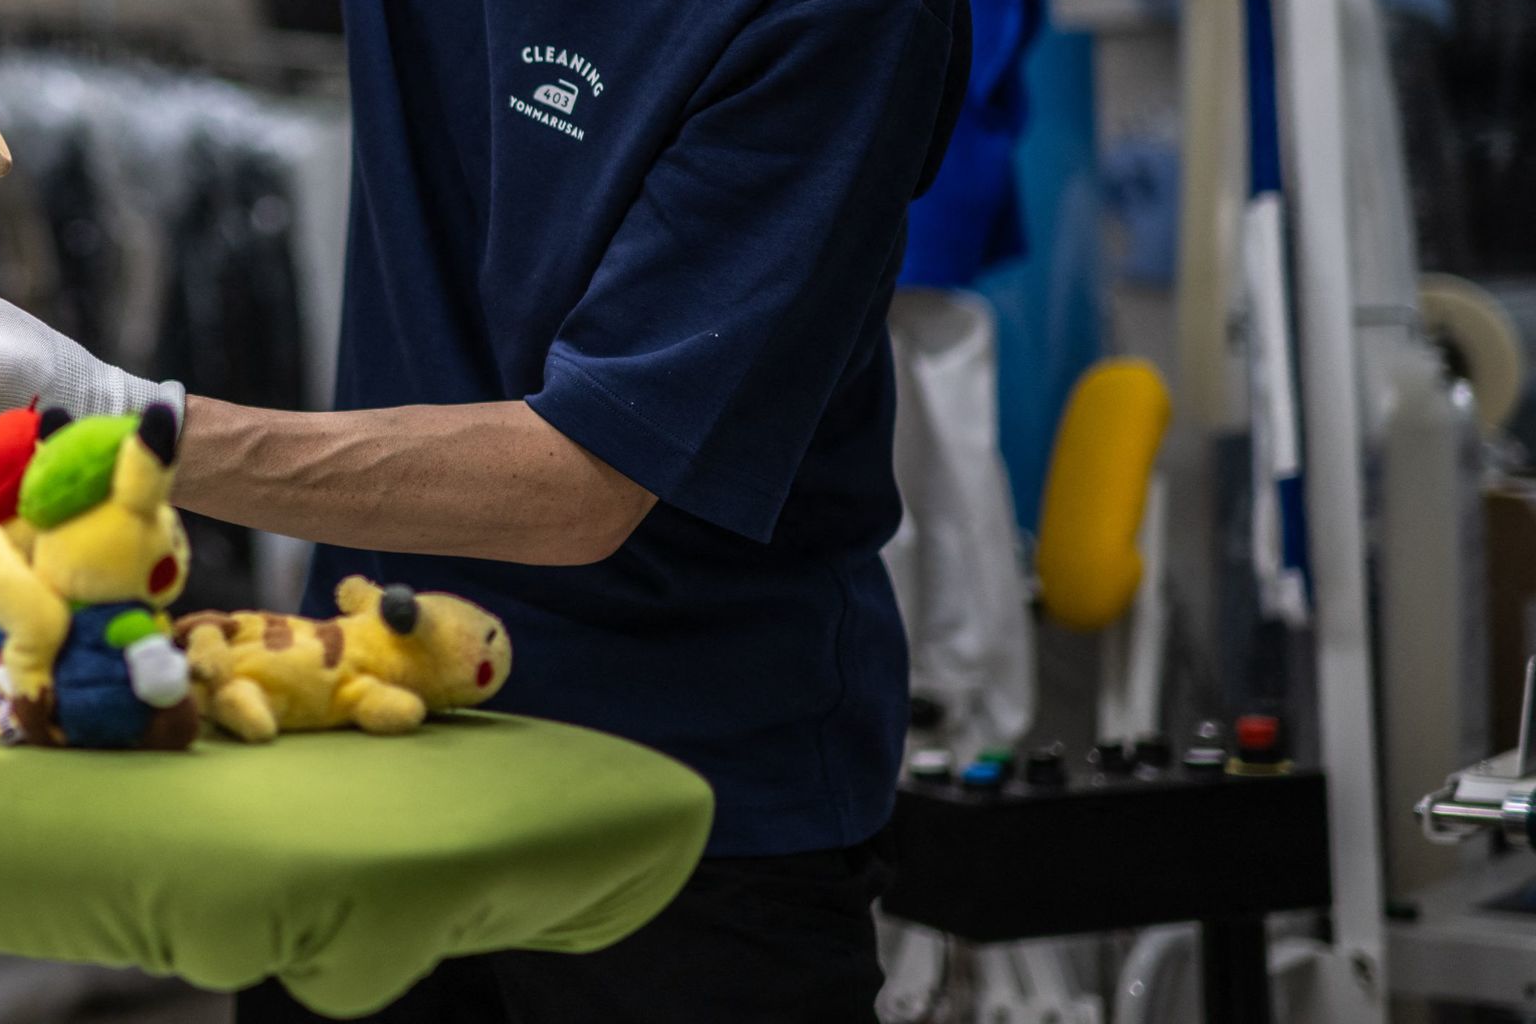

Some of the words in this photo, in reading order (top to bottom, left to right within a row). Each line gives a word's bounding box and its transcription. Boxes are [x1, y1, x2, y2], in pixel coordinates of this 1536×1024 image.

[522, 46, 604, 97] CLEANING
[510, 95, 584, 141] YONMARUSAN
[543, 88, 570, 108] 403
